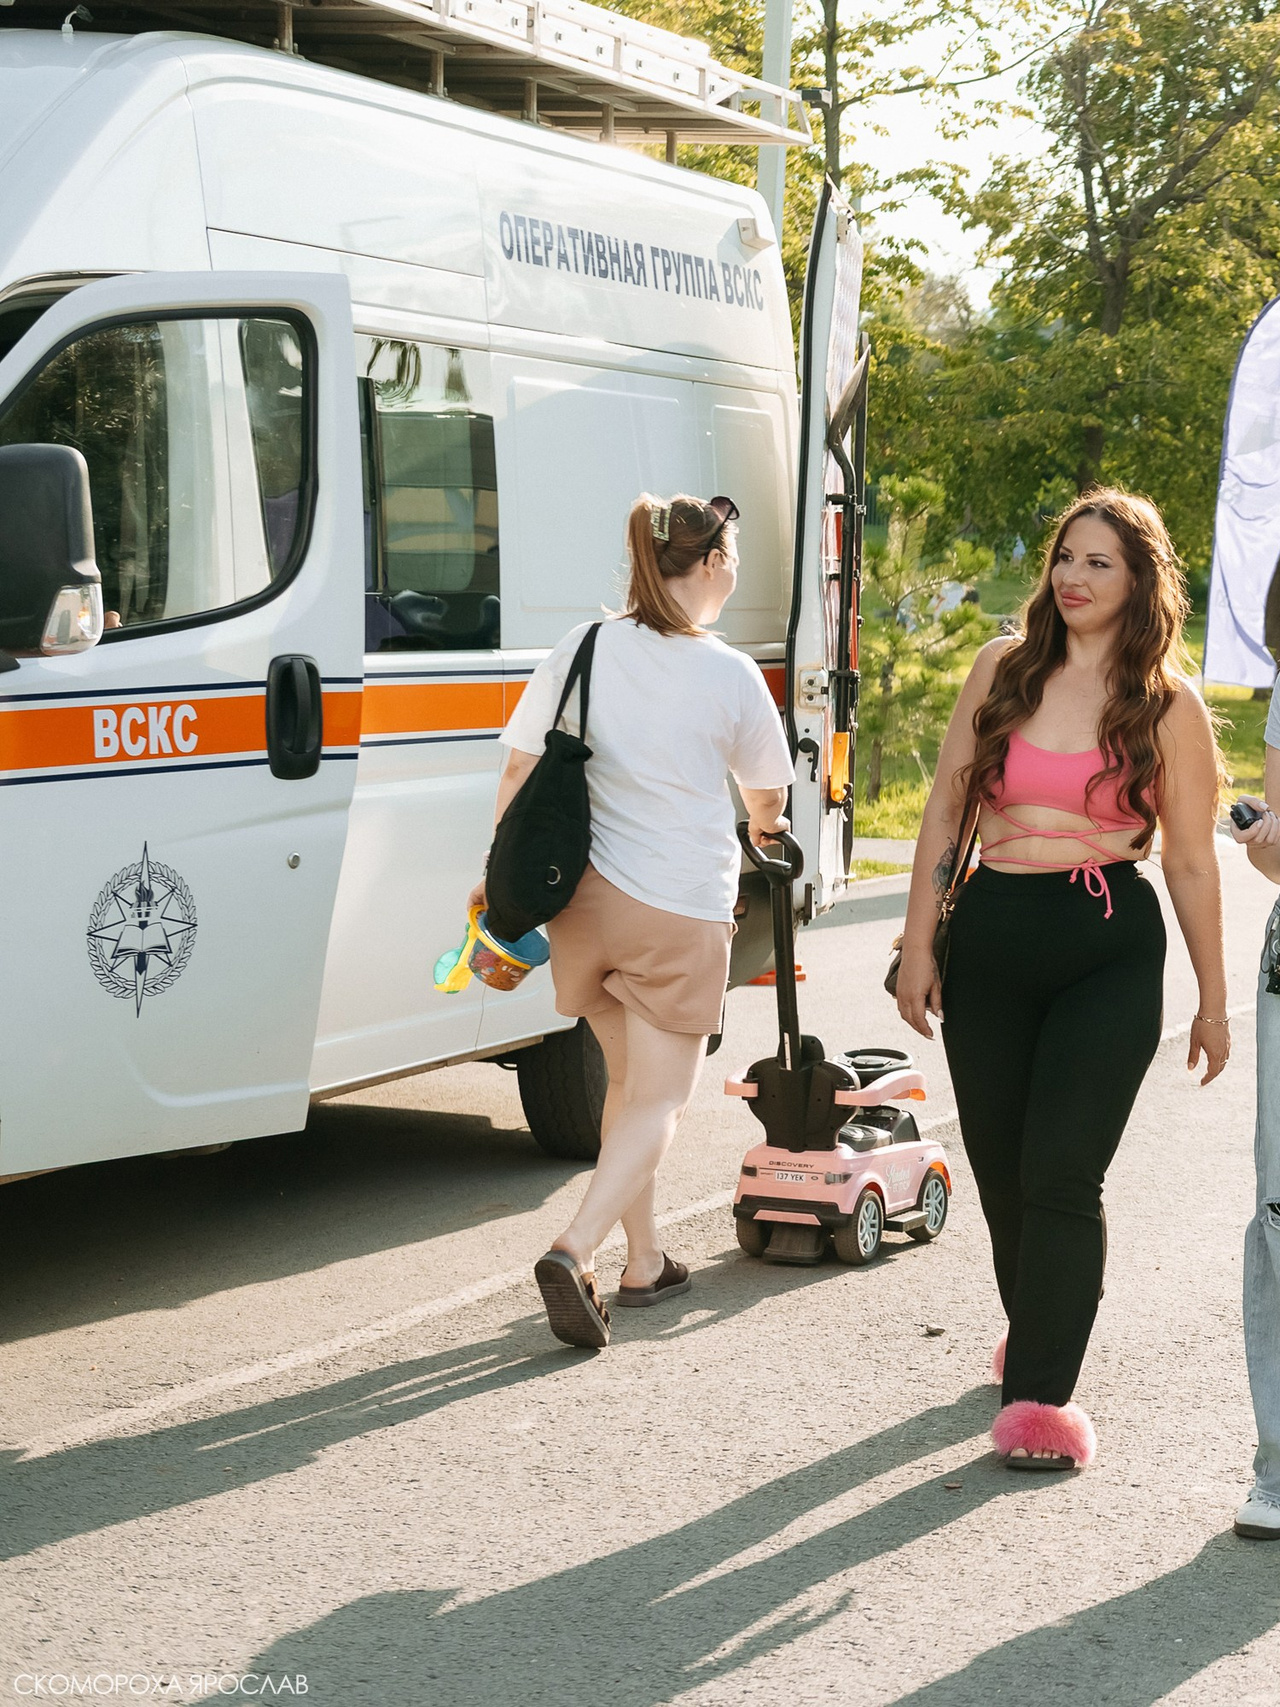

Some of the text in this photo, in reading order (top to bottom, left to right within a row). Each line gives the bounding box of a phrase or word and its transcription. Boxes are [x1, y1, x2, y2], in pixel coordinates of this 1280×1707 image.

[500, 210, 764, 311] ОПЕРАТИВНАЯ ГРУППА ВСКС
[93, 704, 198, 758] ВСКС
[768, 1160, 815, 1169] DISCOVERY
[776, 1172, 789, 1180] 137
[790, 1173, 805, 1182] YEK
